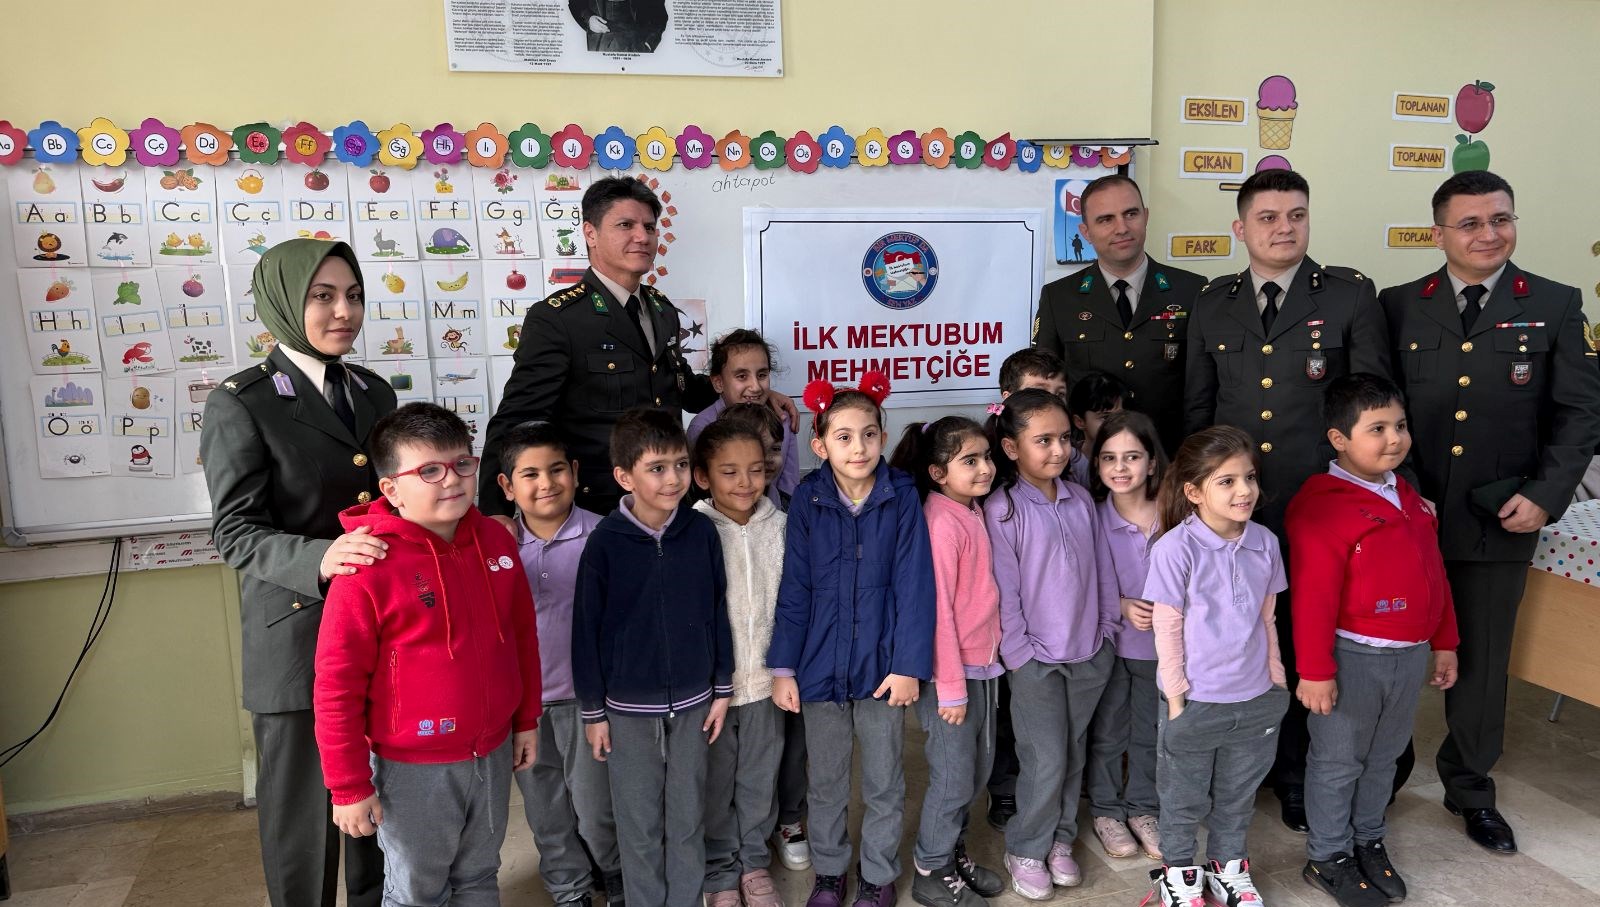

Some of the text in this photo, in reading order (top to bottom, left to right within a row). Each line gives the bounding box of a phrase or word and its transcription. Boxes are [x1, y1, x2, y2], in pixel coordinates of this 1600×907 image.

[1188, 102, 1239, 119] EKSİLEN
[1399, 98, 1446, 115] TOPLANAN
[47, 138, 63, 150] Bb
[96, 138, 113, 150] Cc
[148, 138, 165, 152] Çç
[199, 136, 215, 150] Dd
[251, 136, 265, 148] Ee
[300, 139, 313, 151] Ff
[345, 139, 363, 155] Gg
[389, 138, 407, 158] Ğğ
[435, 138, 451, 151] Hh
[568, 143, 577, 157] Jj
[609, 141, 621, 156] Kk
[652, 143, 661, 156] Ll
[686, 142, 703, 154] Mm
[830, 142, 841, 157] Pp
[869, 144, 878, 155] Rr
[901, 145, 910, 155] Ss
[932, 144, 941, 156] Şş
[964, 144, 973, 156] Tt
[993, 144, 1004, 156] Uu
[727, 146, 741, 157] Nn
[761, 146, 775, 157] Oo
[795, 145, 810, 160] Öö
[1396, 150, 1443, 165] TOPLANAN
[1193, 155, 1233, 173] ÇIKAN
[712, 174, 777, 193] ahtapot
[26, 203, 66, 224] A a
[93, 203, 132, 224] B b
[161, 202, 201, 223] C c
[299, 201, 334, 221] D d
[367, 202, 400, 221] E e
[429, 201, 459, 220] F f
[487, 201, 523, 227] G g
[545, 197, 581, 227] Ğ ğ
[1397, 231, 1433, 243] TOPLAM
[1185, 239, 1218, 255] FARK
[246, 303, 257, 322] J
[378, 301, 391, 321] L
[435, 300, 477, 319] M m
[499, 299, 515, 317] N
[38, 310, 82, 332] H h
[793, 320, 1004, 351] İLK MEKTUBUM
[807, 348, 991, 385] MEHMETÇİĞE
[190, 412, 203, 432] R
[122, 416, 160, 445] P p
